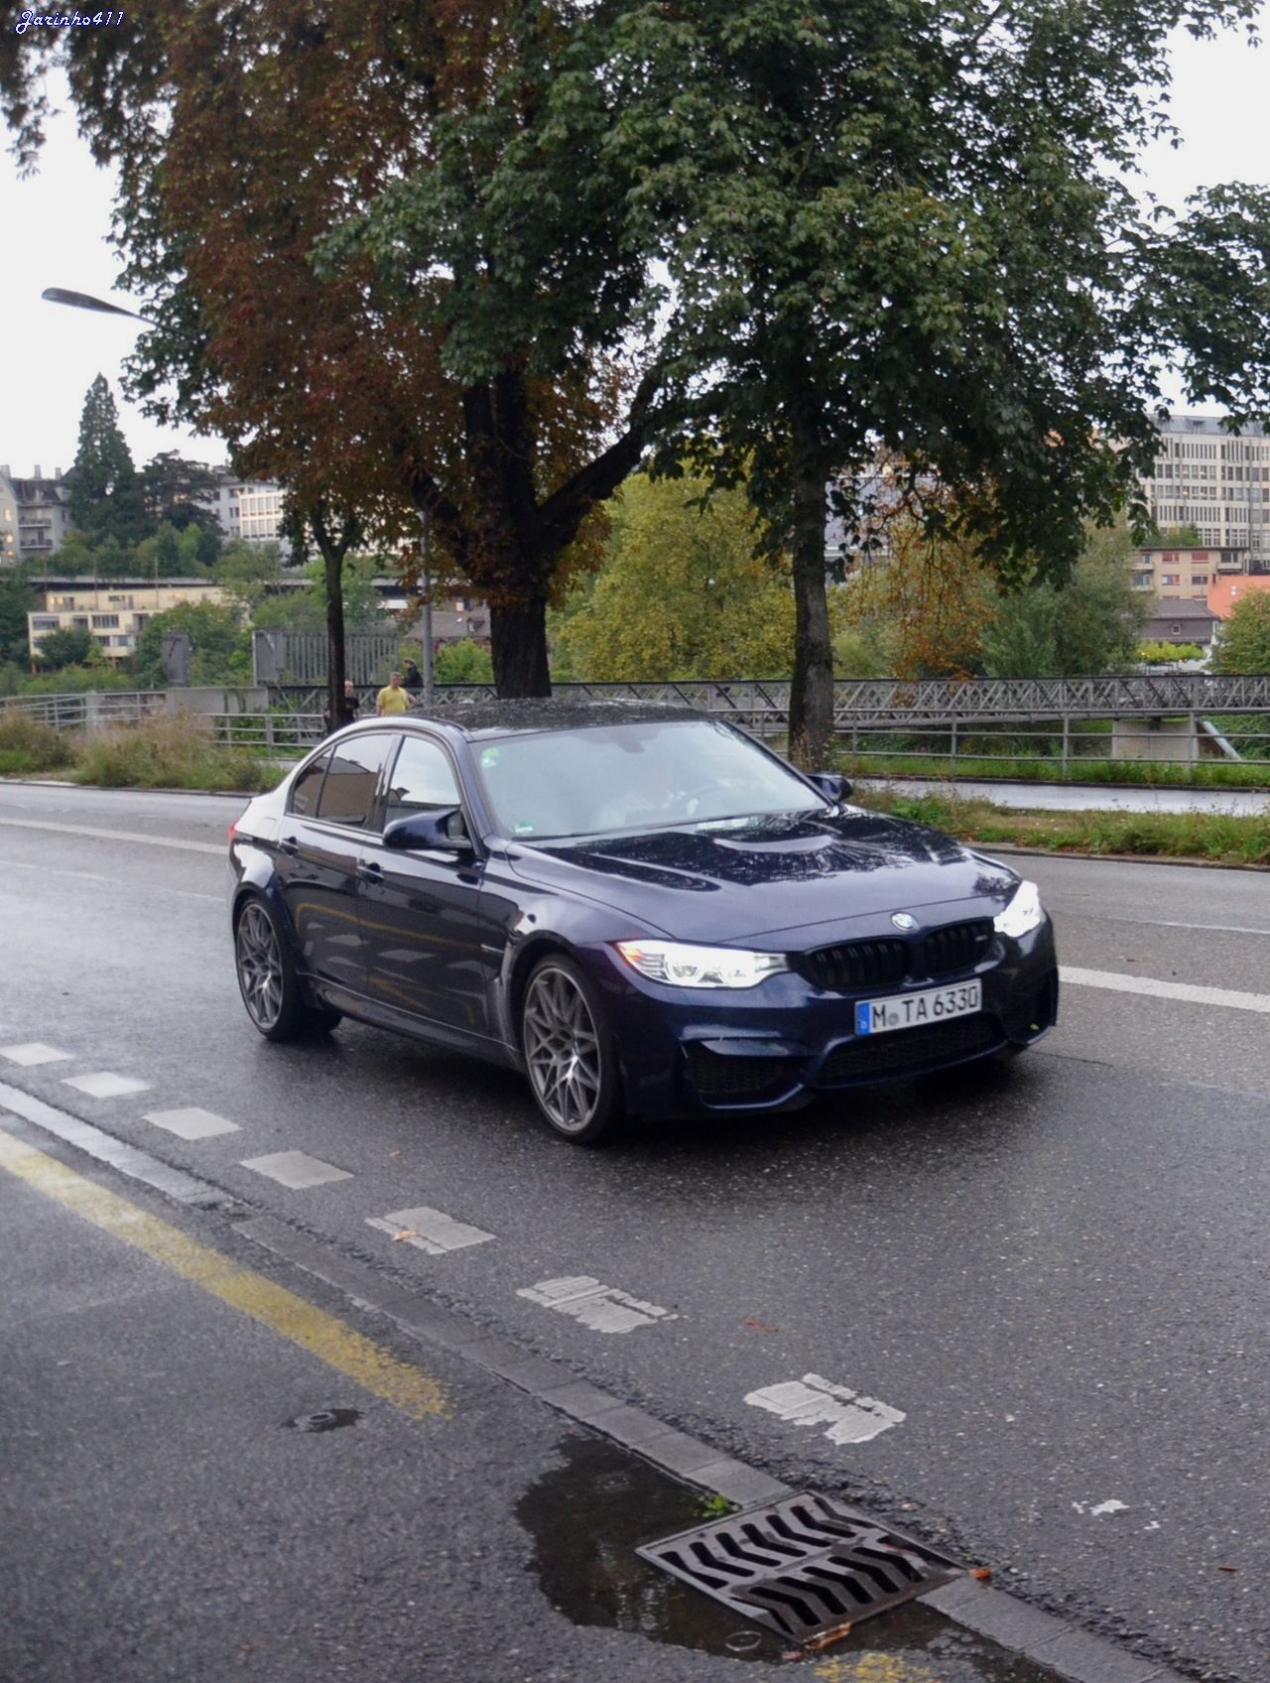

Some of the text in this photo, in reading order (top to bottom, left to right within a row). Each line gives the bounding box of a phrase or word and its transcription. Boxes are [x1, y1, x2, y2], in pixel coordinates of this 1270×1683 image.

[872, 985, 979, 1029] M TA 6330
